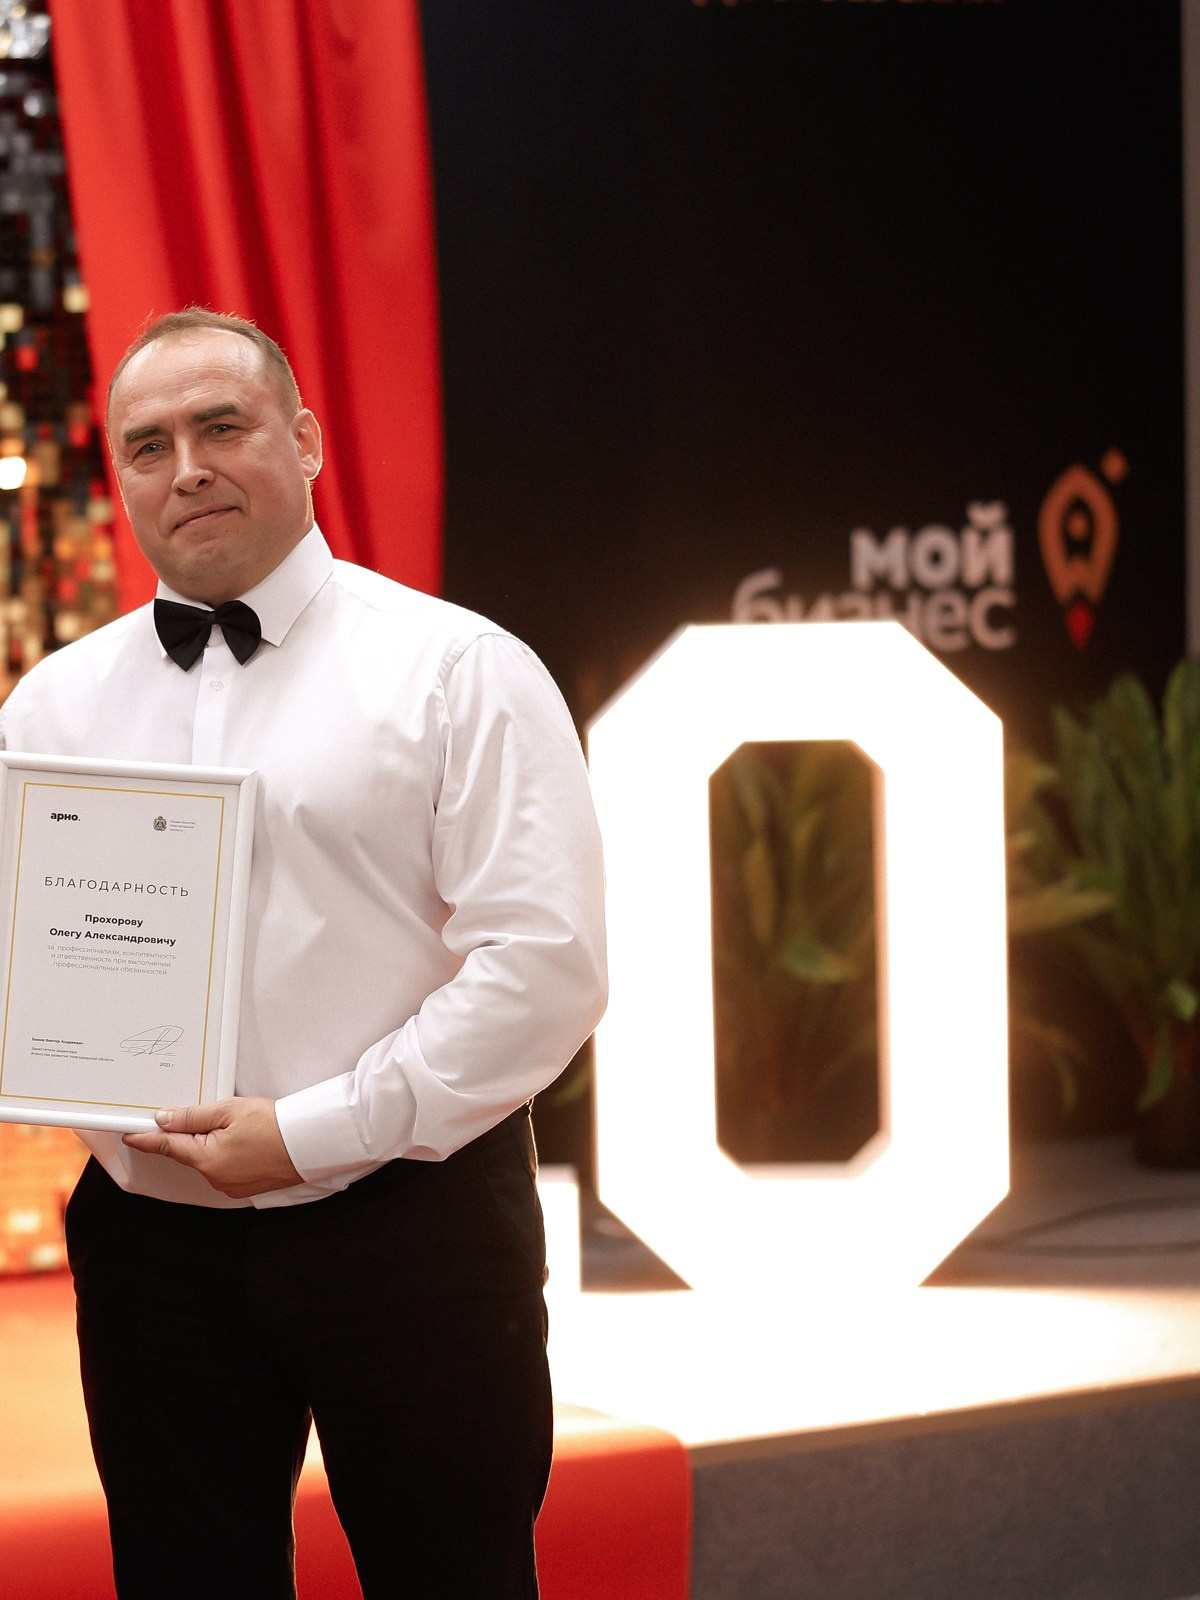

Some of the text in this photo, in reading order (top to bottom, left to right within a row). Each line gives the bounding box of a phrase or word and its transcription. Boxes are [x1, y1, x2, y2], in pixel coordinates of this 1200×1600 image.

[850, 502, 1015, 590] мой
[50, 812, 81, 822] арно.
[44, 876, 189, 897] БЛАГОДАРНОСТЬ
[84, 914, 144, 928] Прохорову
[49, 928, 177, 947] Олегу Александровичу
[57, 953, 112, 963] ответственность
[113, 957, 127, 965] при
[128, 959, 171, 968] выполнении
[122, 950, 177, 960] компетентность
[53, 961, 168, 976] профессиональных обязанностей
